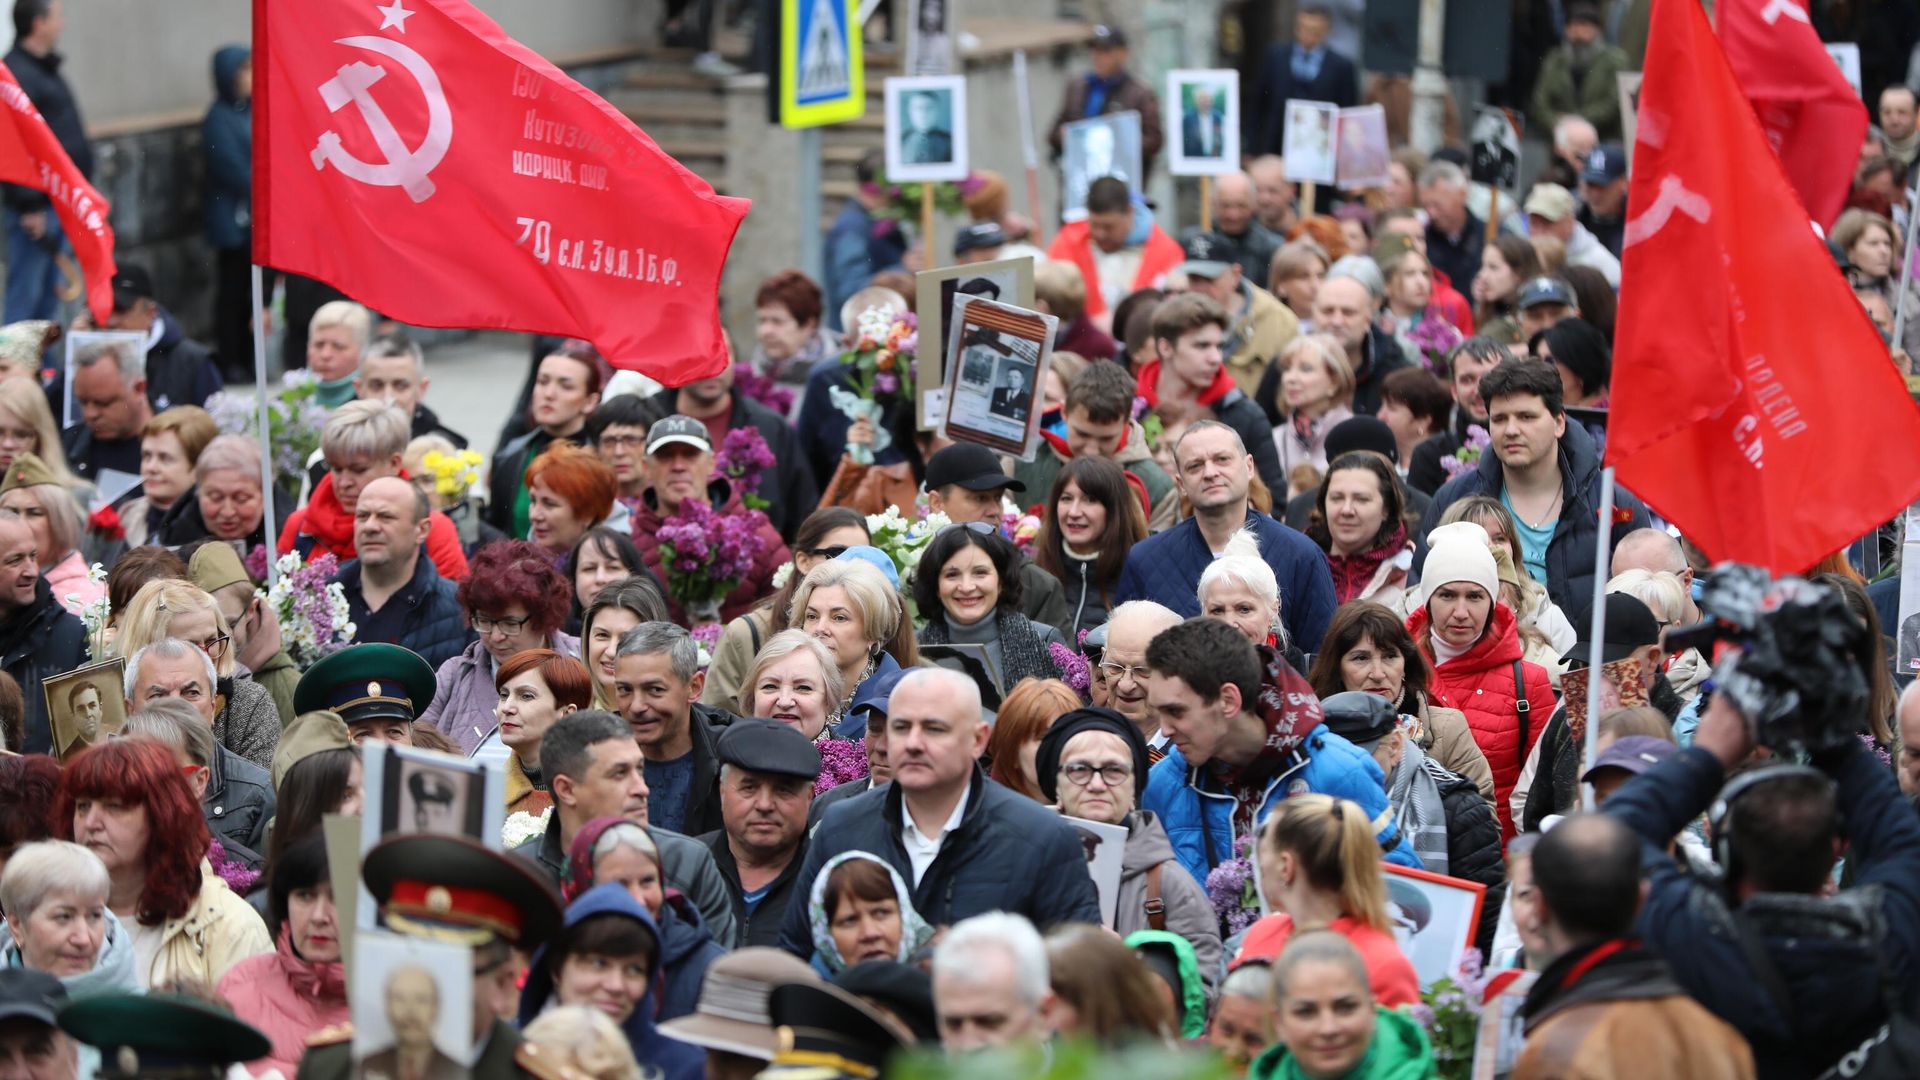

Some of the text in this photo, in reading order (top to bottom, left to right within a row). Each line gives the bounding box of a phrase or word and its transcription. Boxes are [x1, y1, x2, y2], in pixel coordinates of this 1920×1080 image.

[513, 150, 610, 191] ИДРИЦК. ДИВ.
[666, 419, 686, 432] M
